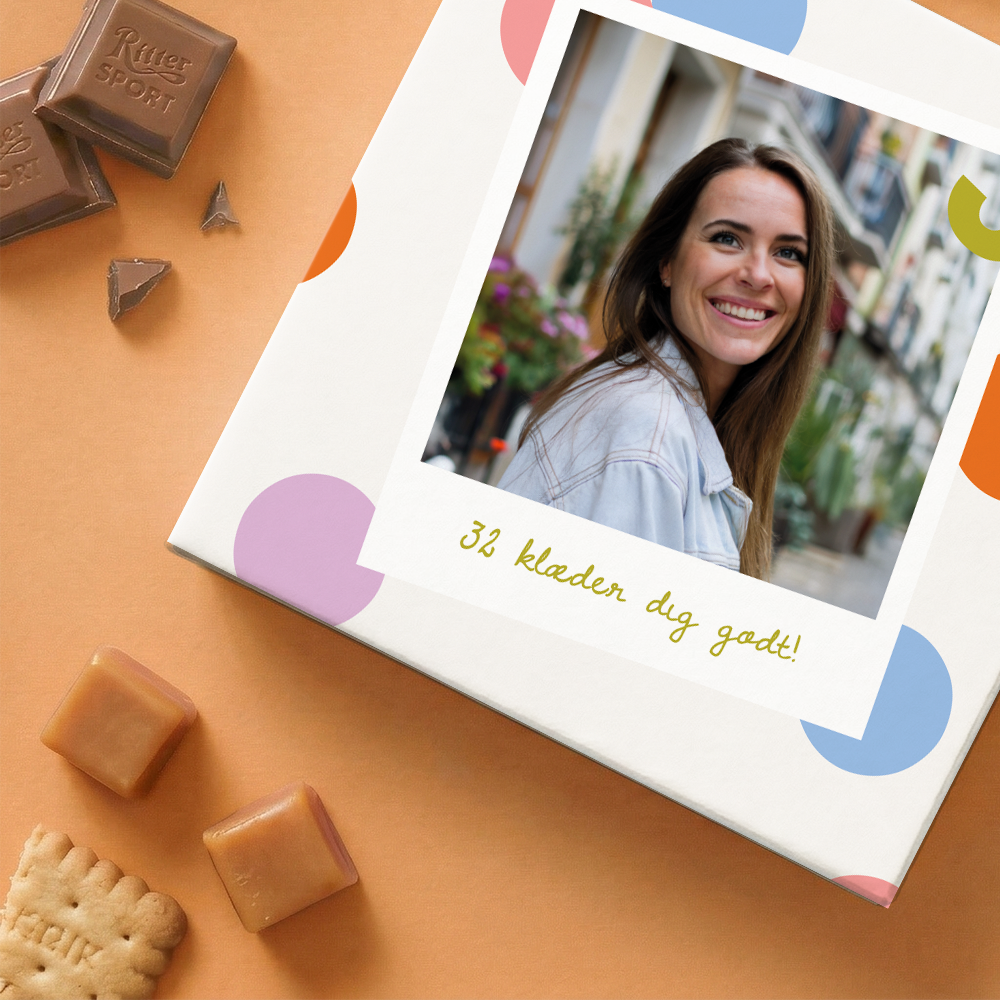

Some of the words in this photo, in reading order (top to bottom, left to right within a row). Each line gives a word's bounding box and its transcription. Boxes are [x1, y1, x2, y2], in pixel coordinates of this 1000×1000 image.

[105, 26, 192, 86] Ritter
[95, 62, 176, 114] SPORT
[0, 157, 41, 191] ORT
[459, 519, 502, 558] 32
[513, 538, 627, 603] klæder
[645, 590, 700, 643] dig
[709, 625, 802, 663] godt!
